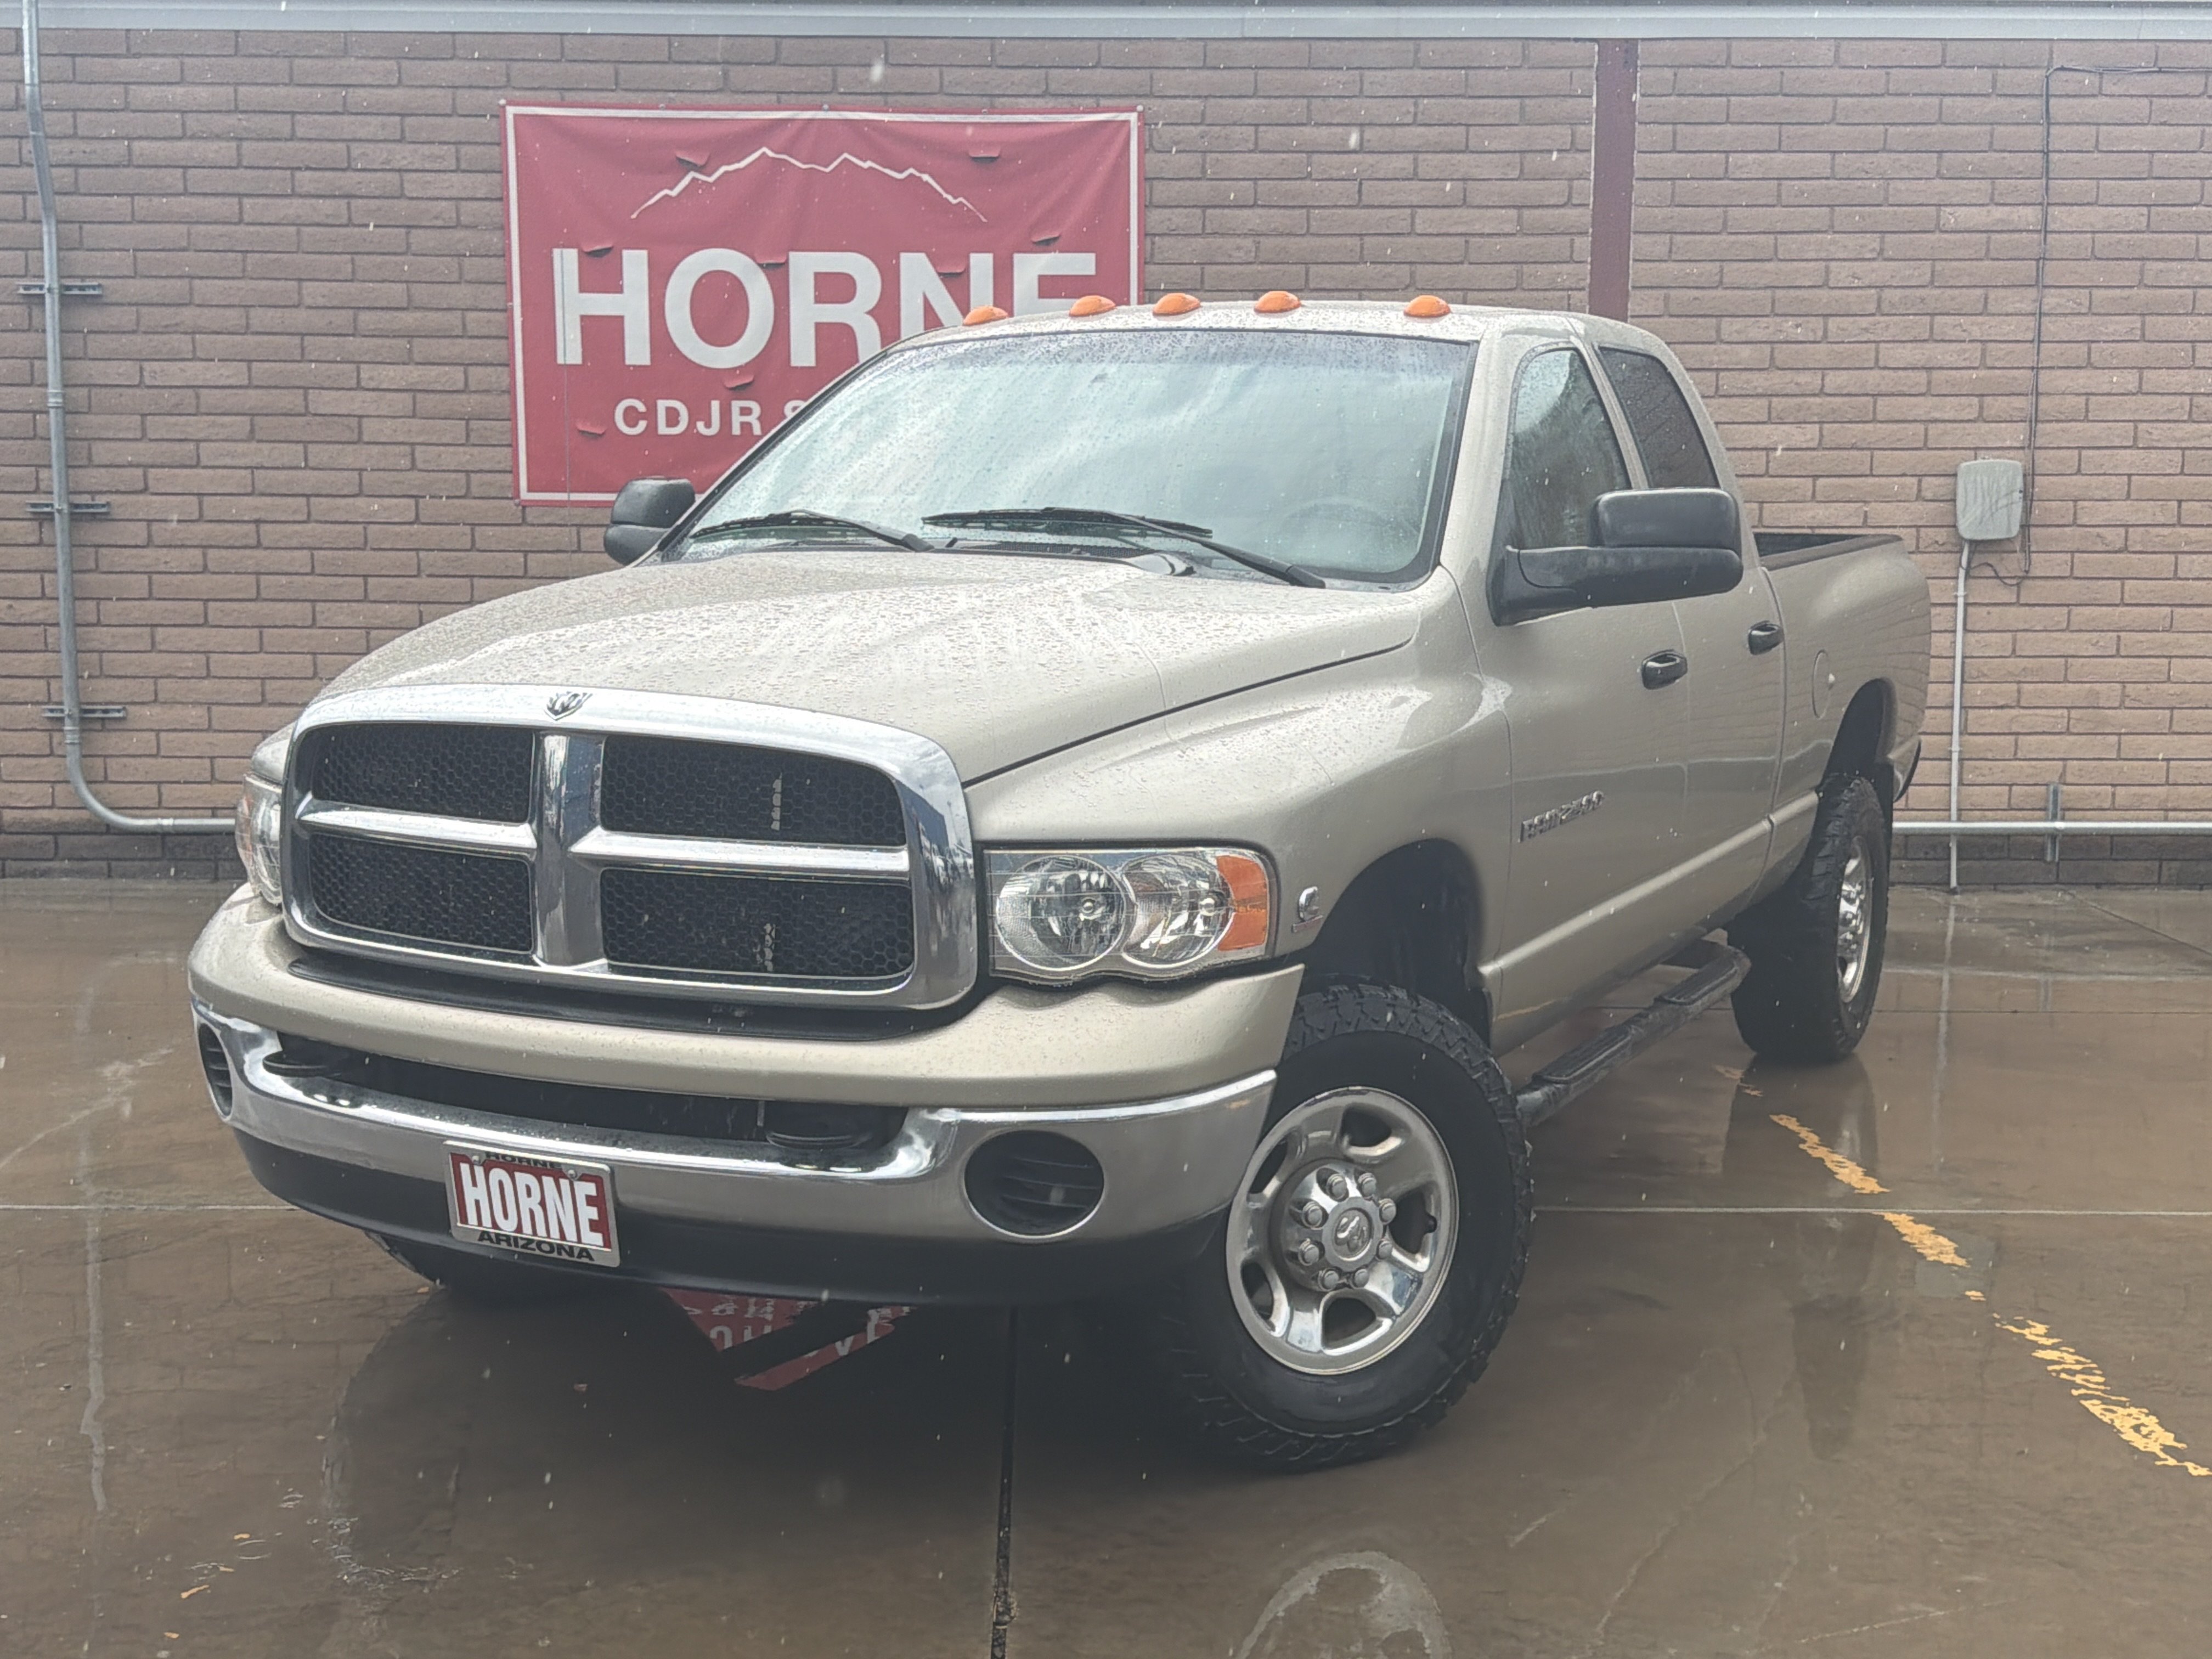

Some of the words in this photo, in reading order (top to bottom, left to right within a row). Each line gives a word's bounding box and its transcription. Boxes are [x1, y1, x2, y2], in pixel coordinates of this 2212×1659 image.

[552, 248, 1096, 369] HORNE
[614, 398, 762, 436] CDJR
[460, 1163, 604, 1247] HORNE
[478, 1231, 595, 1261] ARIZONA
